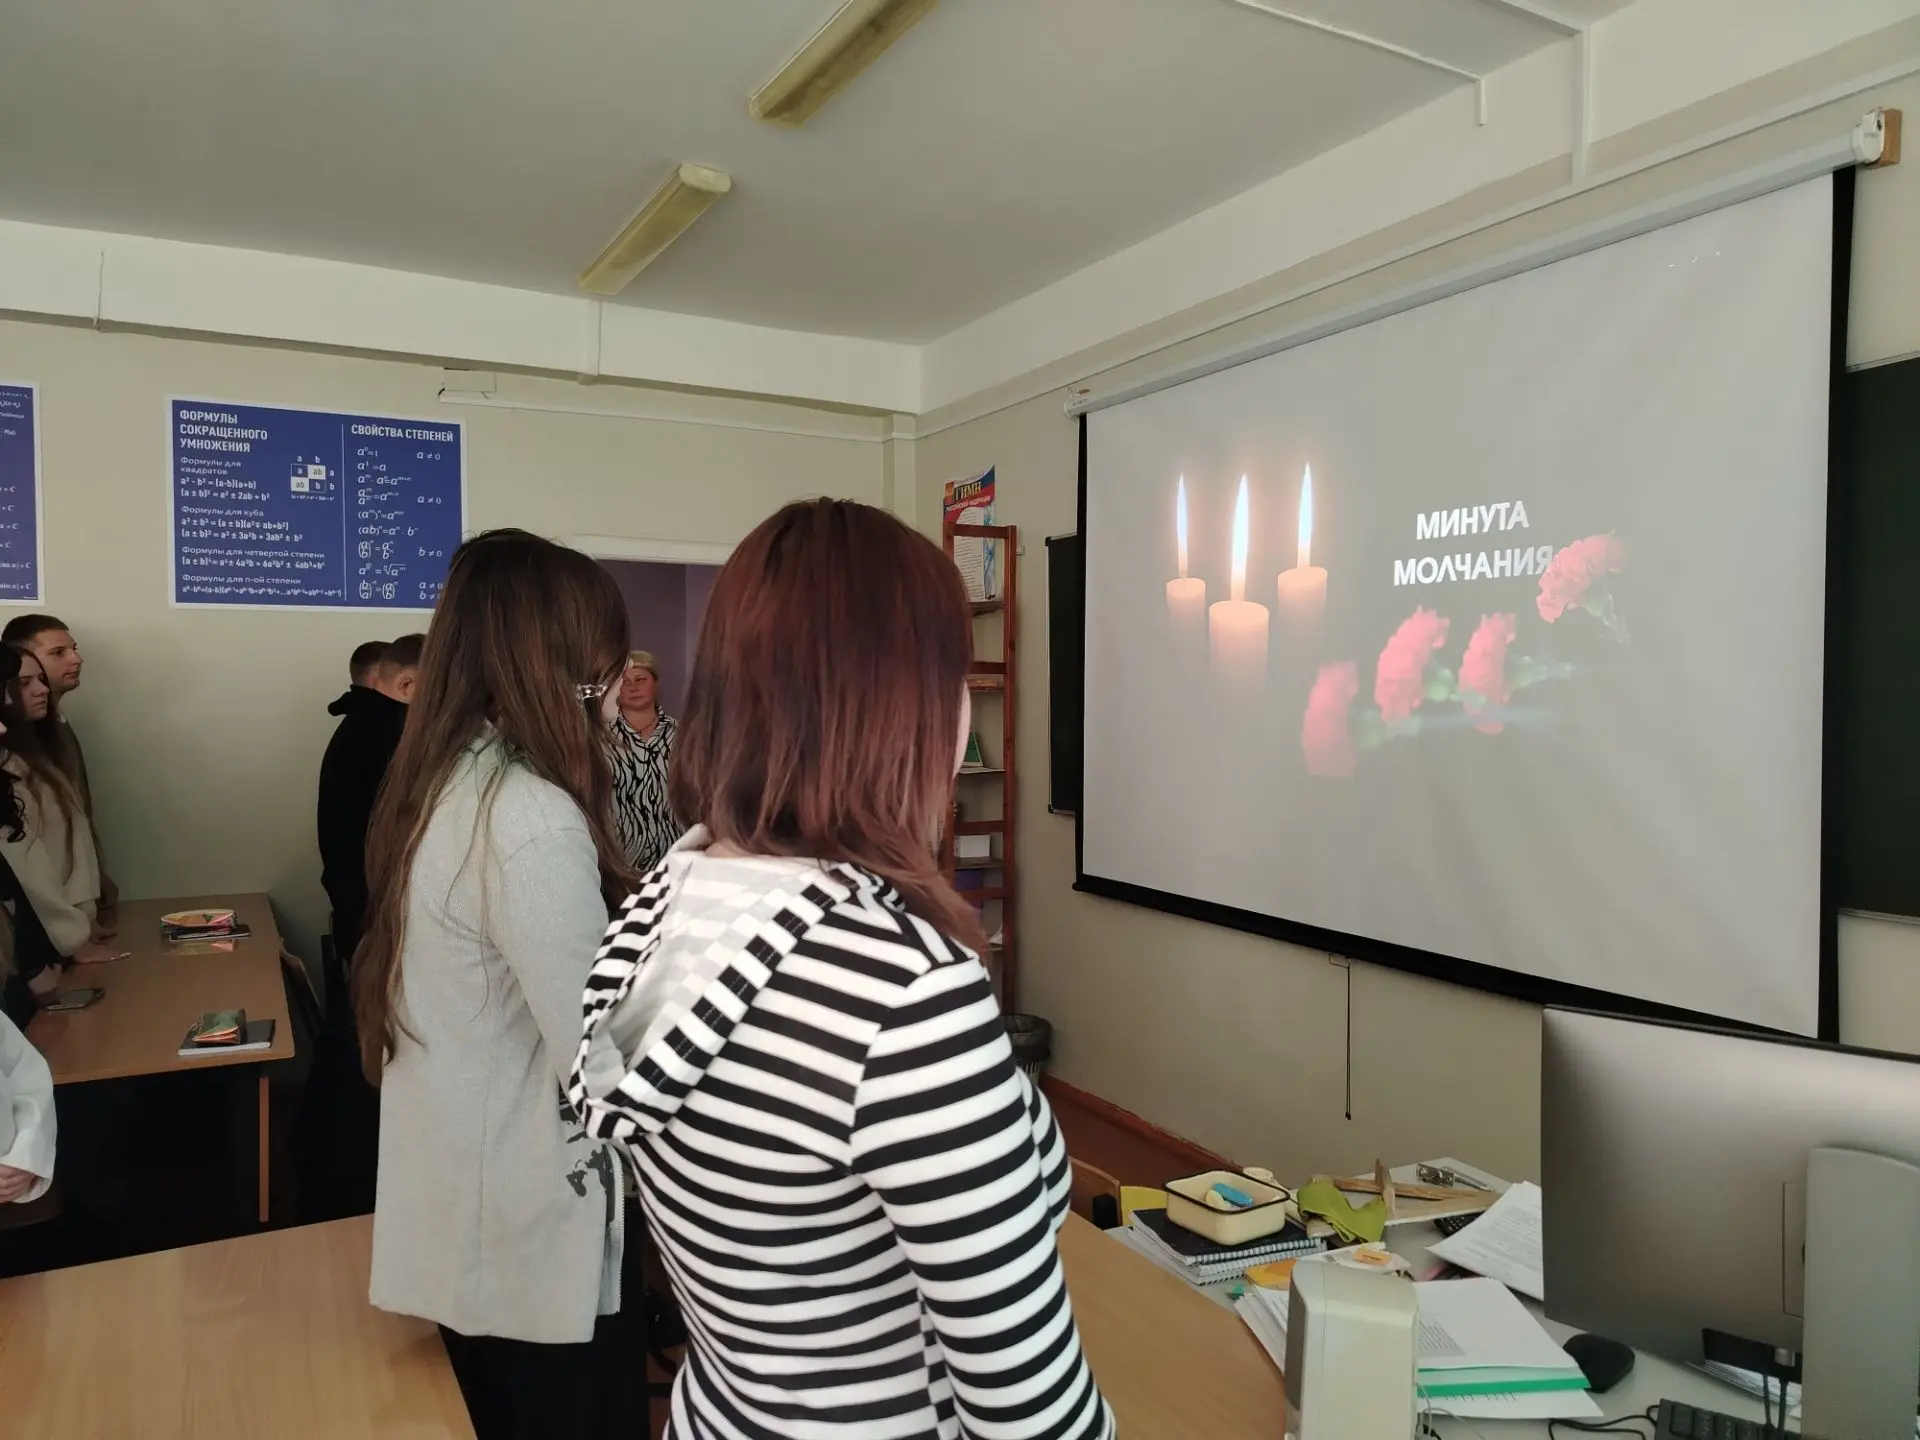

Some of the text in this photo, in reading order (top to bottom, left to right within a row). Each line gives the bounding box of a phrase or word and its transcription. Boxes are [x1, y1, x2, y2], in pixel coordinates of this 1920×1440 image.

[179, 409, 238, 425] ФОРМУЛЫ
[179, 424, 268, 440] СОКРАЩЕННОГО
[351, 424, 454, 442] СВОЙСТВА СТЕПЕНЕЙ
[180, 438, 251, 453] УМНОЖЕНИЯ
[180, 456, 223, 466] Формулы
[181, 466, 228, 475] квадратов
[953, 480, 981, 501] ГИМН
[181, 505, 224, 515] Формулы
[243, 509, 264, 517] куба
[1416, 500, 1530, 540] МИНУТА
[181, 545, 225, 555] Формулы
[244, 549, 289, 558] четвертой
[1393, 545, 1553, 586] МОЛЧАНИЯ
[182, 573, 225, 583] Формулы
